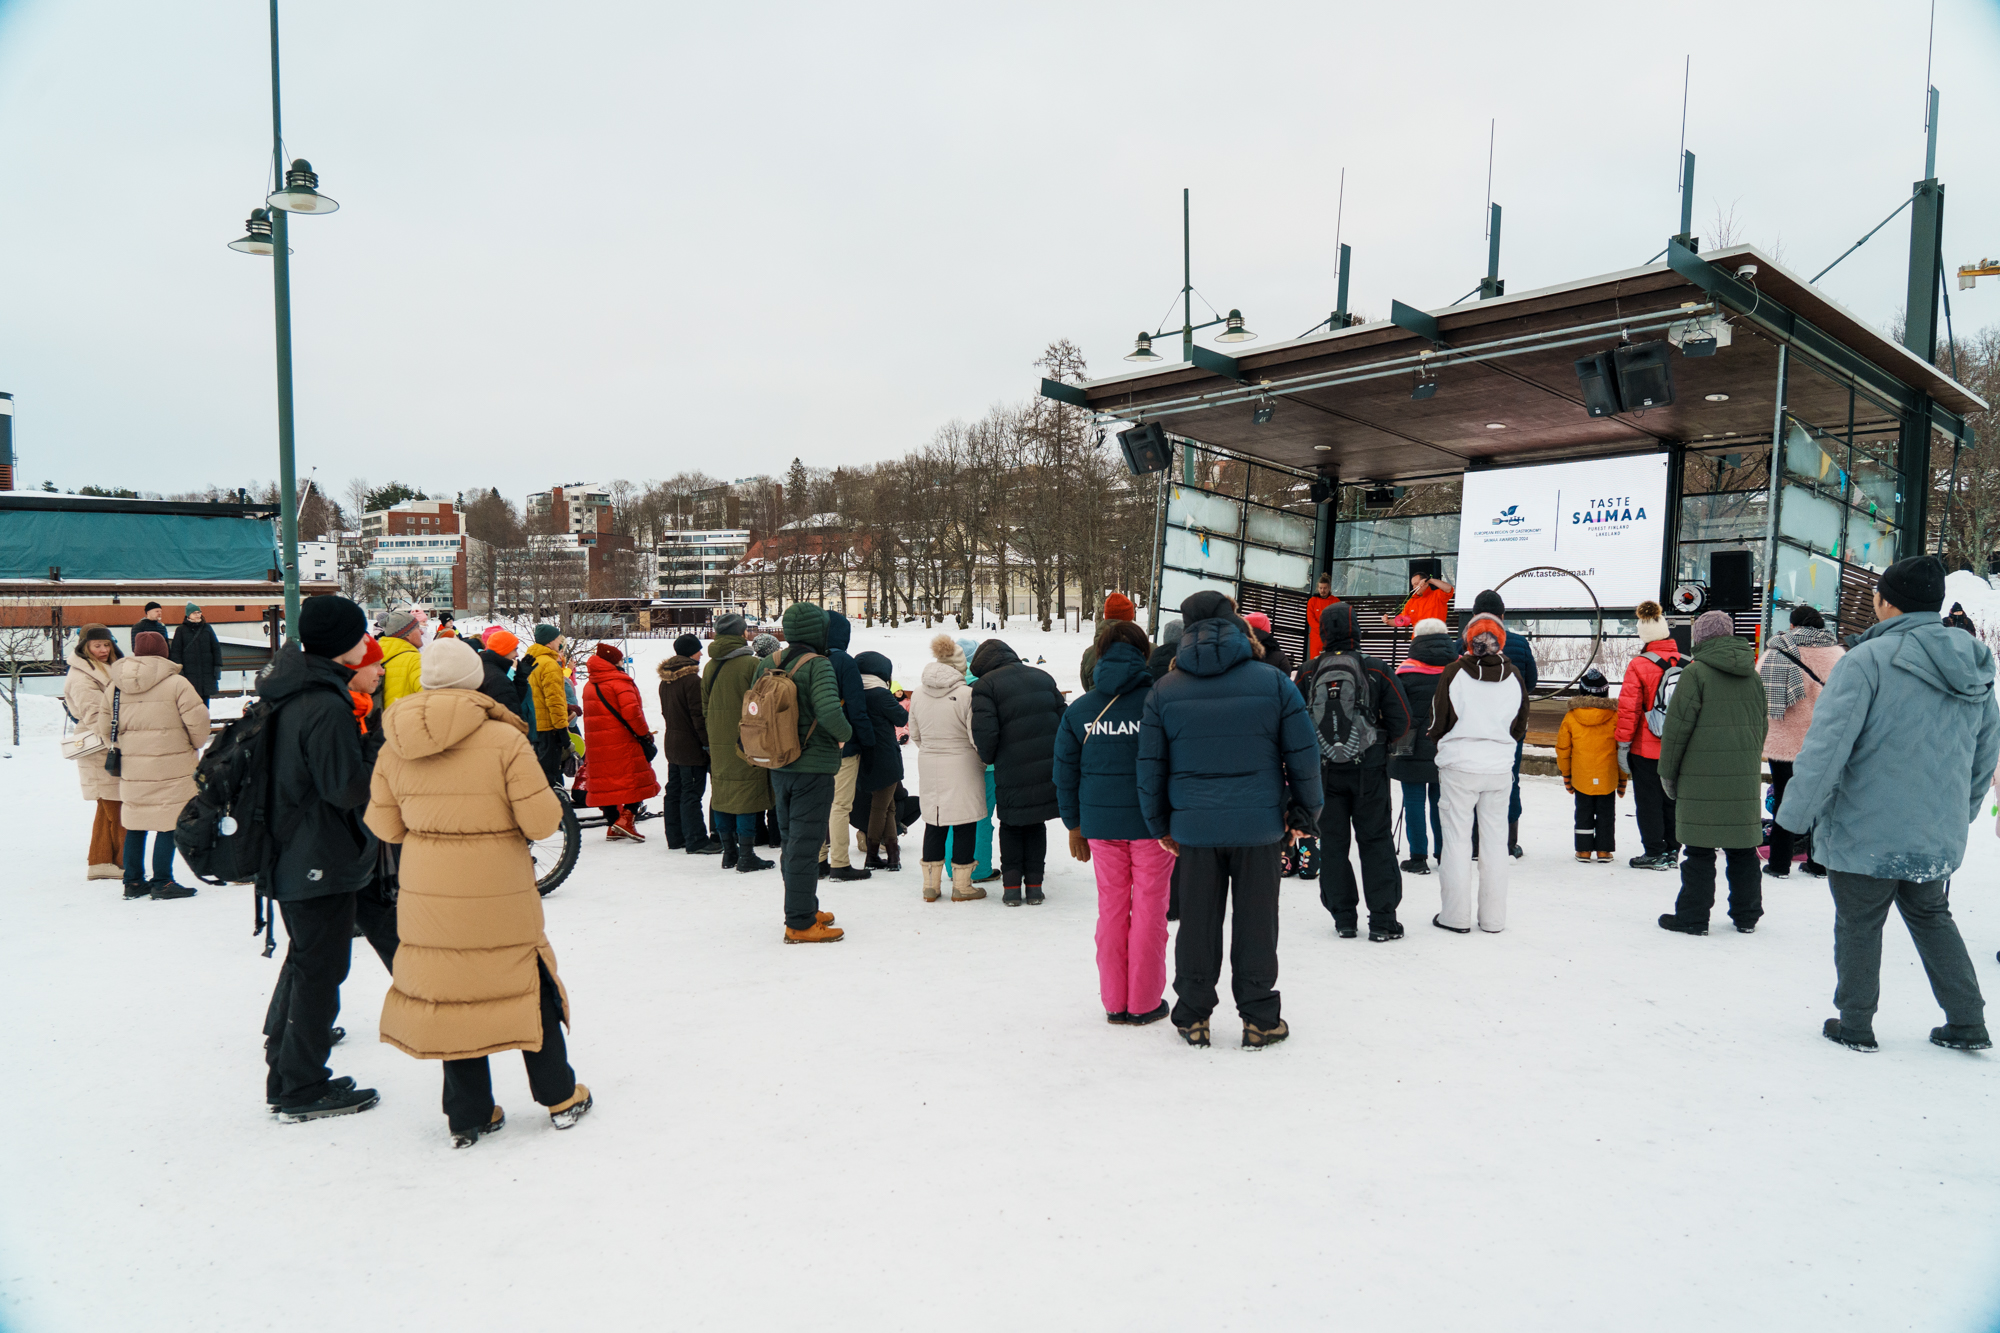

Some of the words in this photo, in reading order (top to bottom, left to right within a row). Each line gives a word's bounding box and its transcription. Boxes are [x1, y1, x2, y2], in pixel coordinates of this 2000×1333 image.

[1590, 497, 1630, 508] TASTE
[1572, 507, 1647, 524] SAIMAA
[1083, 720, 1140, 735] FINLAN
